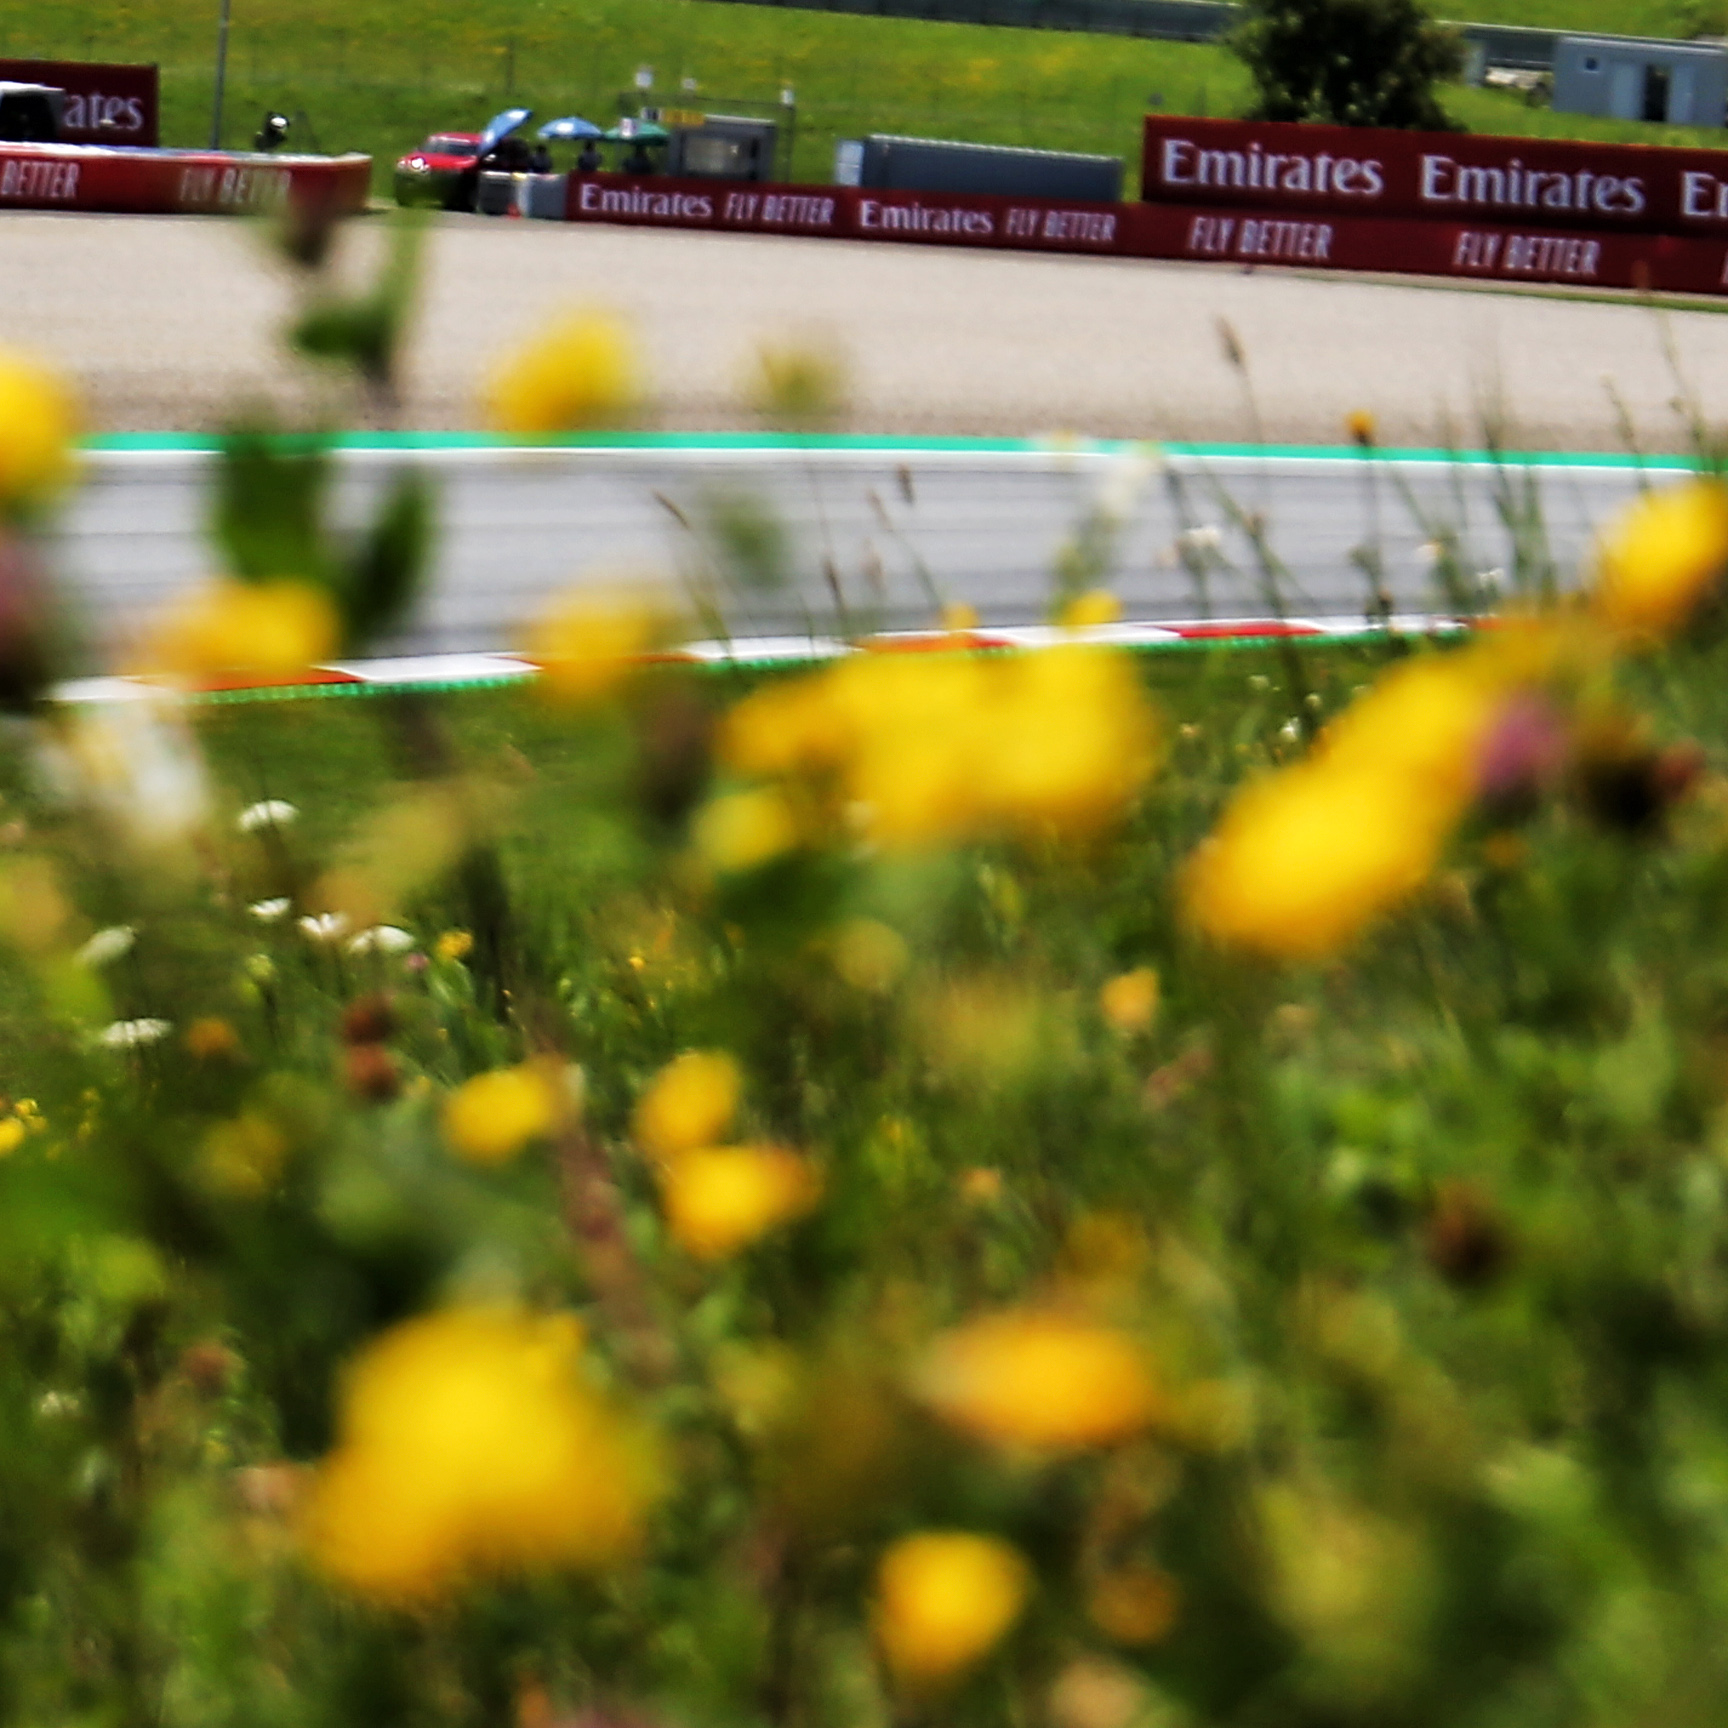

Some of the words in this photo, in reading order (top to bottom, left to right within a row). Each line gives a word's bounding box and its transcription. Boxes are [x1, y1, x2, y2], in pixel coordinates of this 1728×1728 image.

[1, 159, 80, 198] BETTER
[1163, 138, 1384, 196] Emirates
[1420, 154, 1646, 213] Emirates
[580, 183, 712, 218] Emirates
[725, 191, 759, 220] FLY
[760, 194, 835, 223] BETTER
[860, 199, 994, 235] Emirates
[1006, 207, 1041, 237] FLY
[1042, 209, 1117, 241] BETTER
[1189, 217, 1234, 252] FLY
[1237, 219, 1333, 259] BETTER
[1452, 231, 1502, 269] FLY
[1502, 234, 1600, 275] BETTER
